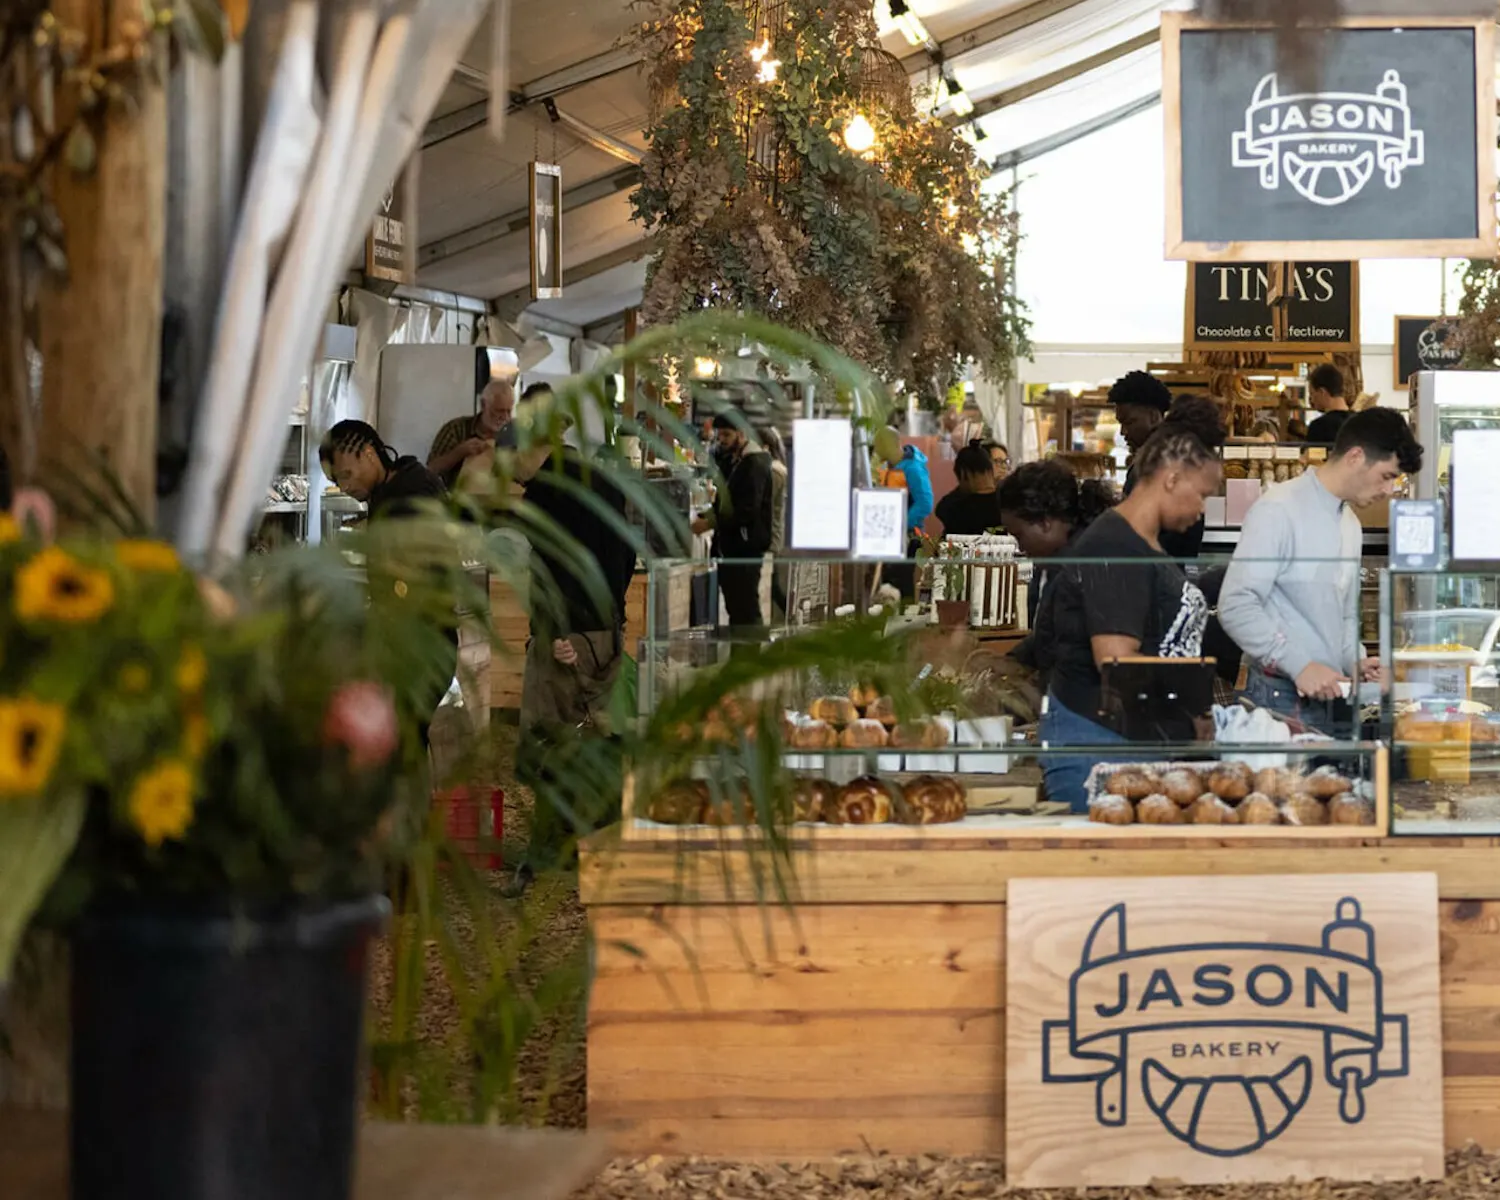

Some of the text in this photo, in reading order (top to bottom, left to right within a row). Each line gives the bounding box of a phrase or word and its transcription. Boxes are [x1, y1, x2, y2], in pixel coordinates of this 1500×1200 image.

[1258, 103, 1394, 134] JASON
[1297, 143, 1358, 155] BAKERY
[1196, 325, 1345, 339] Chocolate & Cfectionery
[1093, 963, 1349, 1018] JASON
[1171, 1040, 1282, 1058] BAKERY
